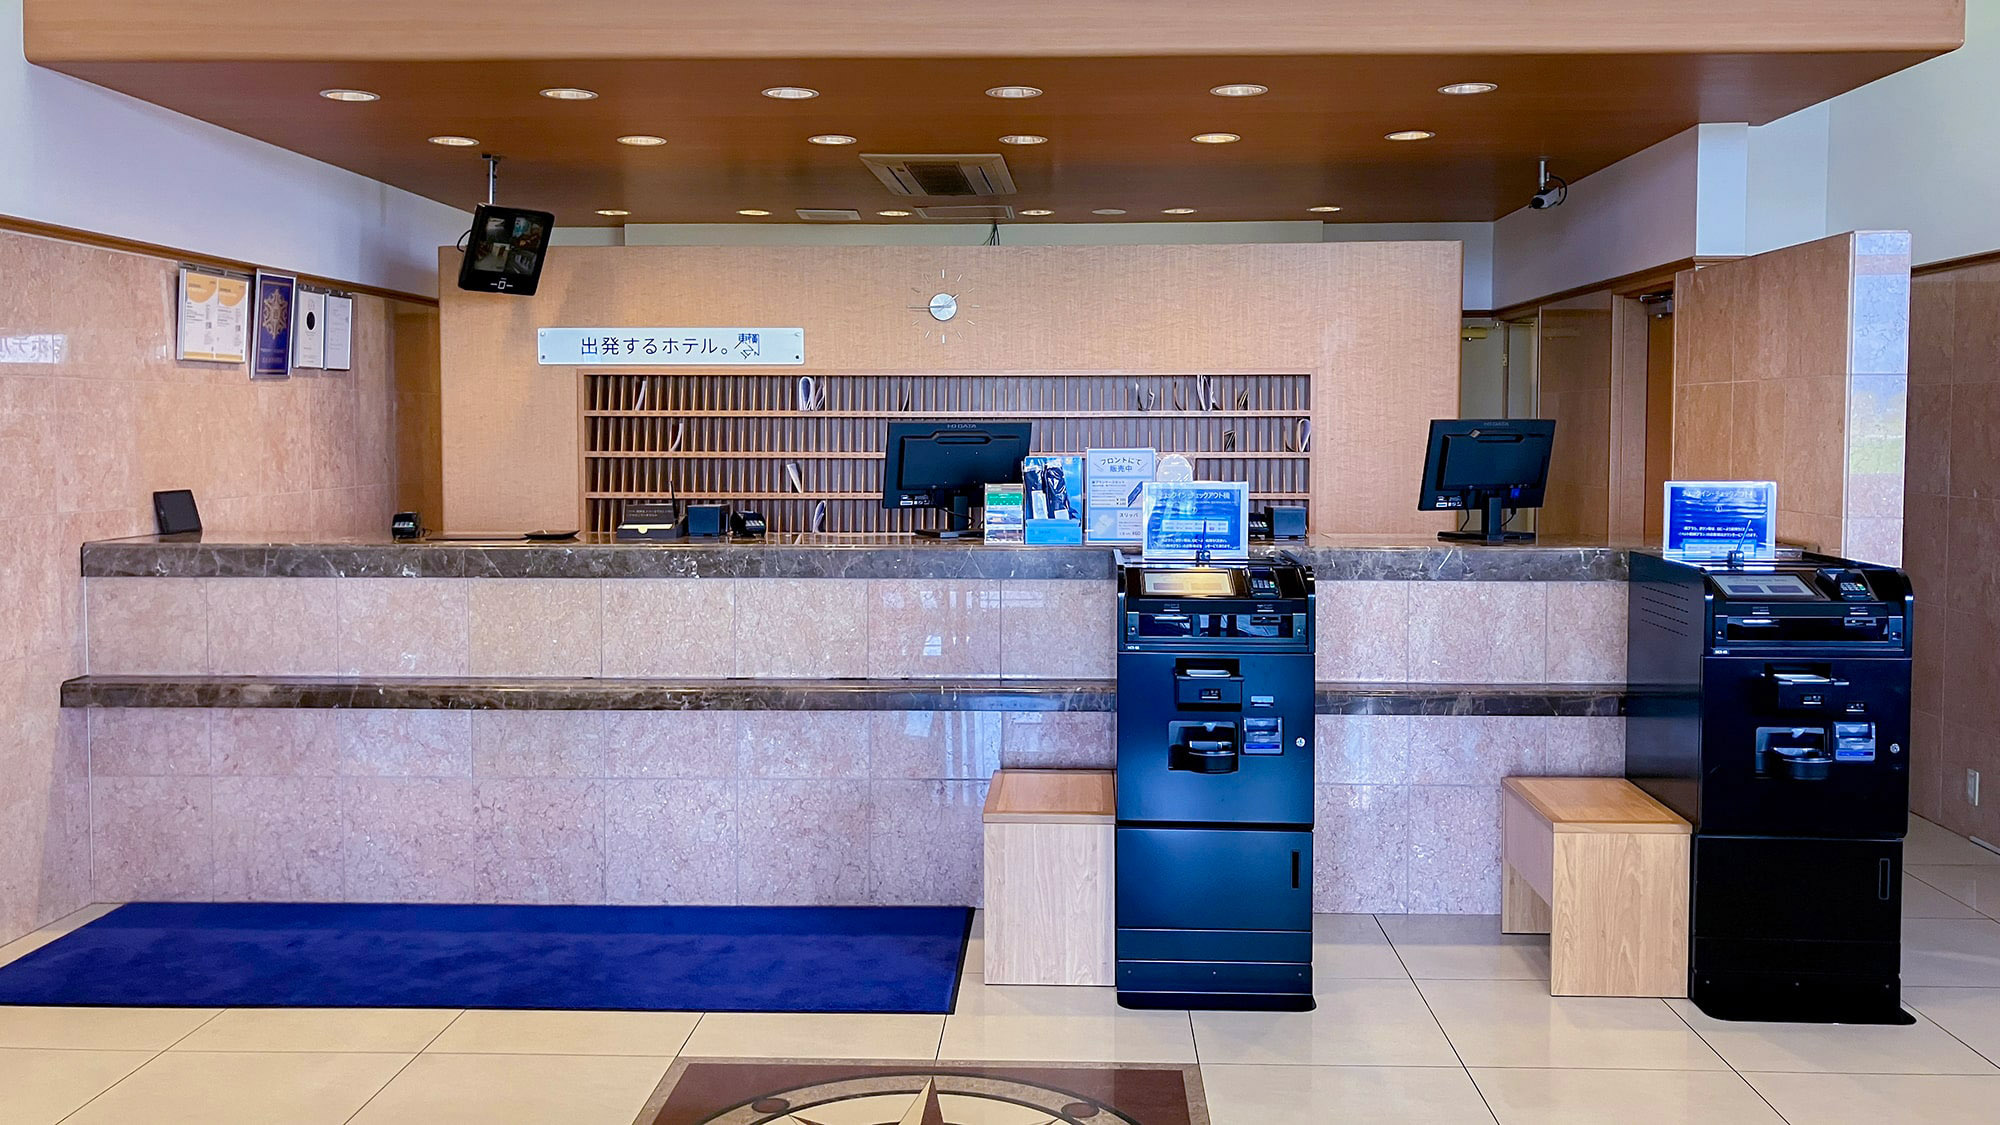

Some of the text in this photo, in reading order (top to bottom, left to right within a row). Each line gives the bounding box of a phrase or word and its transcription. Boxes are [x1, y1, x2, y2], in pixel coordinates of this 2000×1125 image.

[581, 336, 728, 355] 出発するホテル。
[1101, 457, 1142, 465] フロントにて
